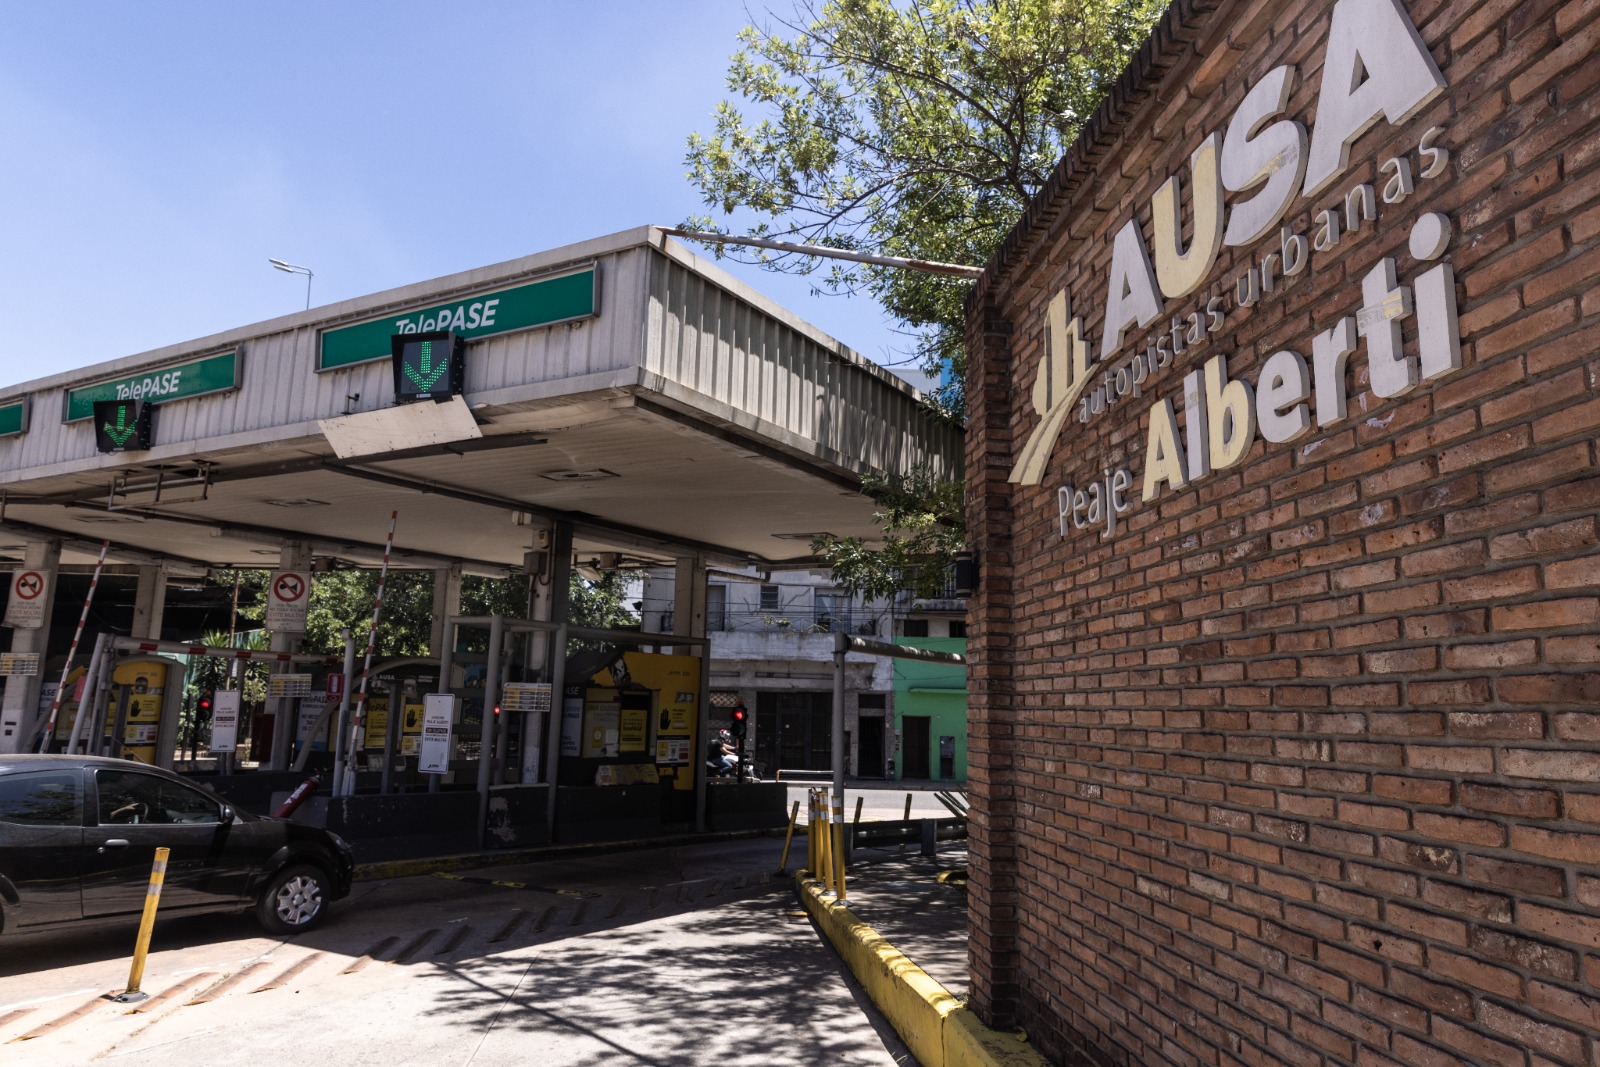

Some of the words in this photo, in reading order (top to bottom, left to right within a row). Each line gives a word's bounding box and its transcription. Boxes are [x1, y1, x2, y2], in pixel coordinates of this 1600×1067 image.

[1079, 296, 1225, 423] autopistas
[1237, 126, 1449, 307] urbanas
[1100, 0, 1447, 361] AUSA
[116, 371, 182, 400] TelePASE
[1058, 467, 1133, 538] Peaje
[1142, 212, 1462, 502] Alberti
